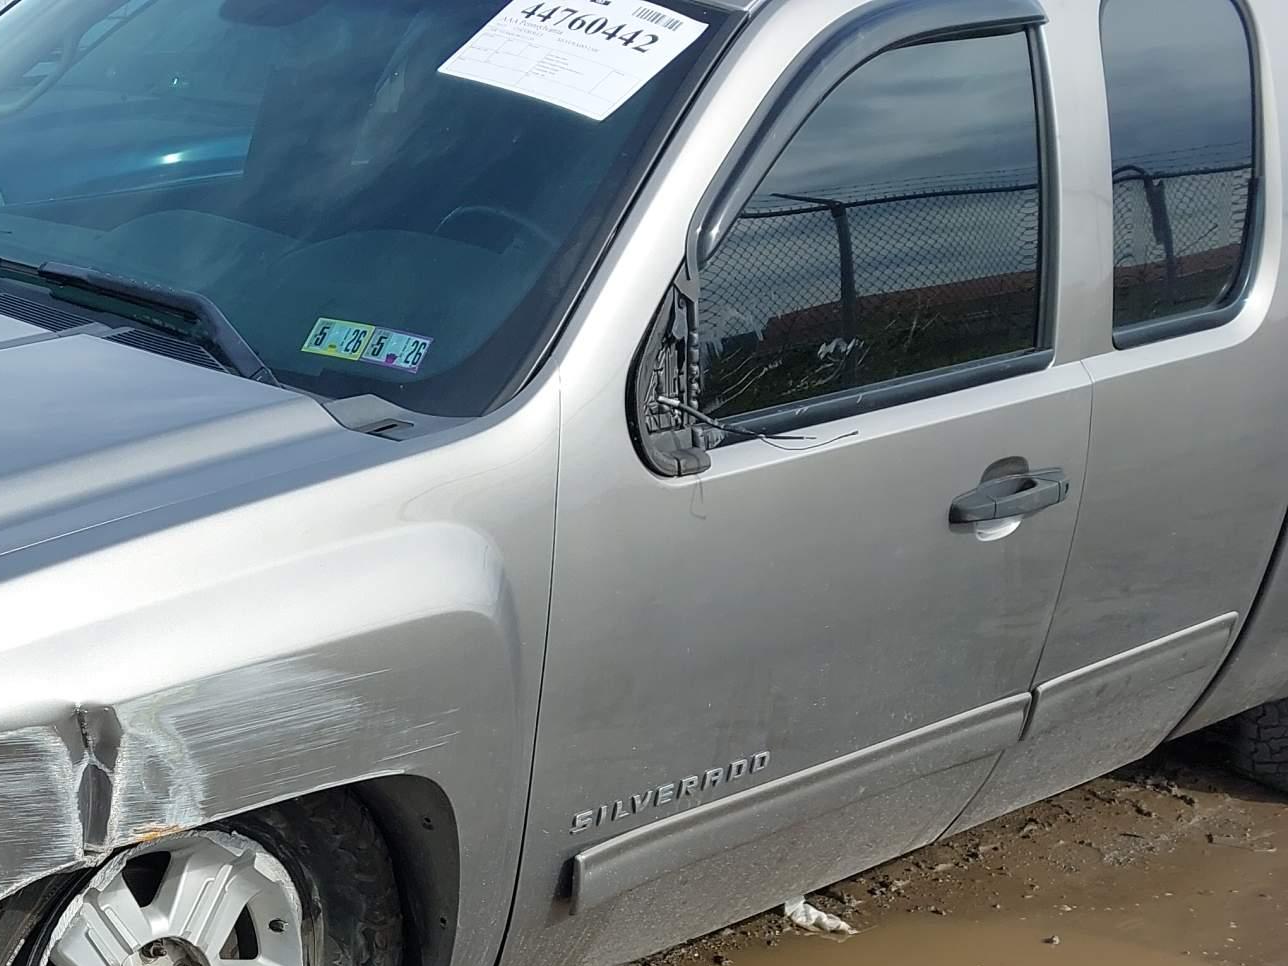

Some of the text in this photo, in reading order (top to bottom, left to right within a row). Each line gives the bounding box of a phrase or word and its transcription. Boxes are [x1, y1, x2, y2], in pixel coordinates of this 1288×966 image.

[520, 2, 660, 53] 44760442
[314, 325, 367, 354] 5 26
[371, 335, 427, 366] 5 26
[569, 750, 771, 835] SILVERADO
